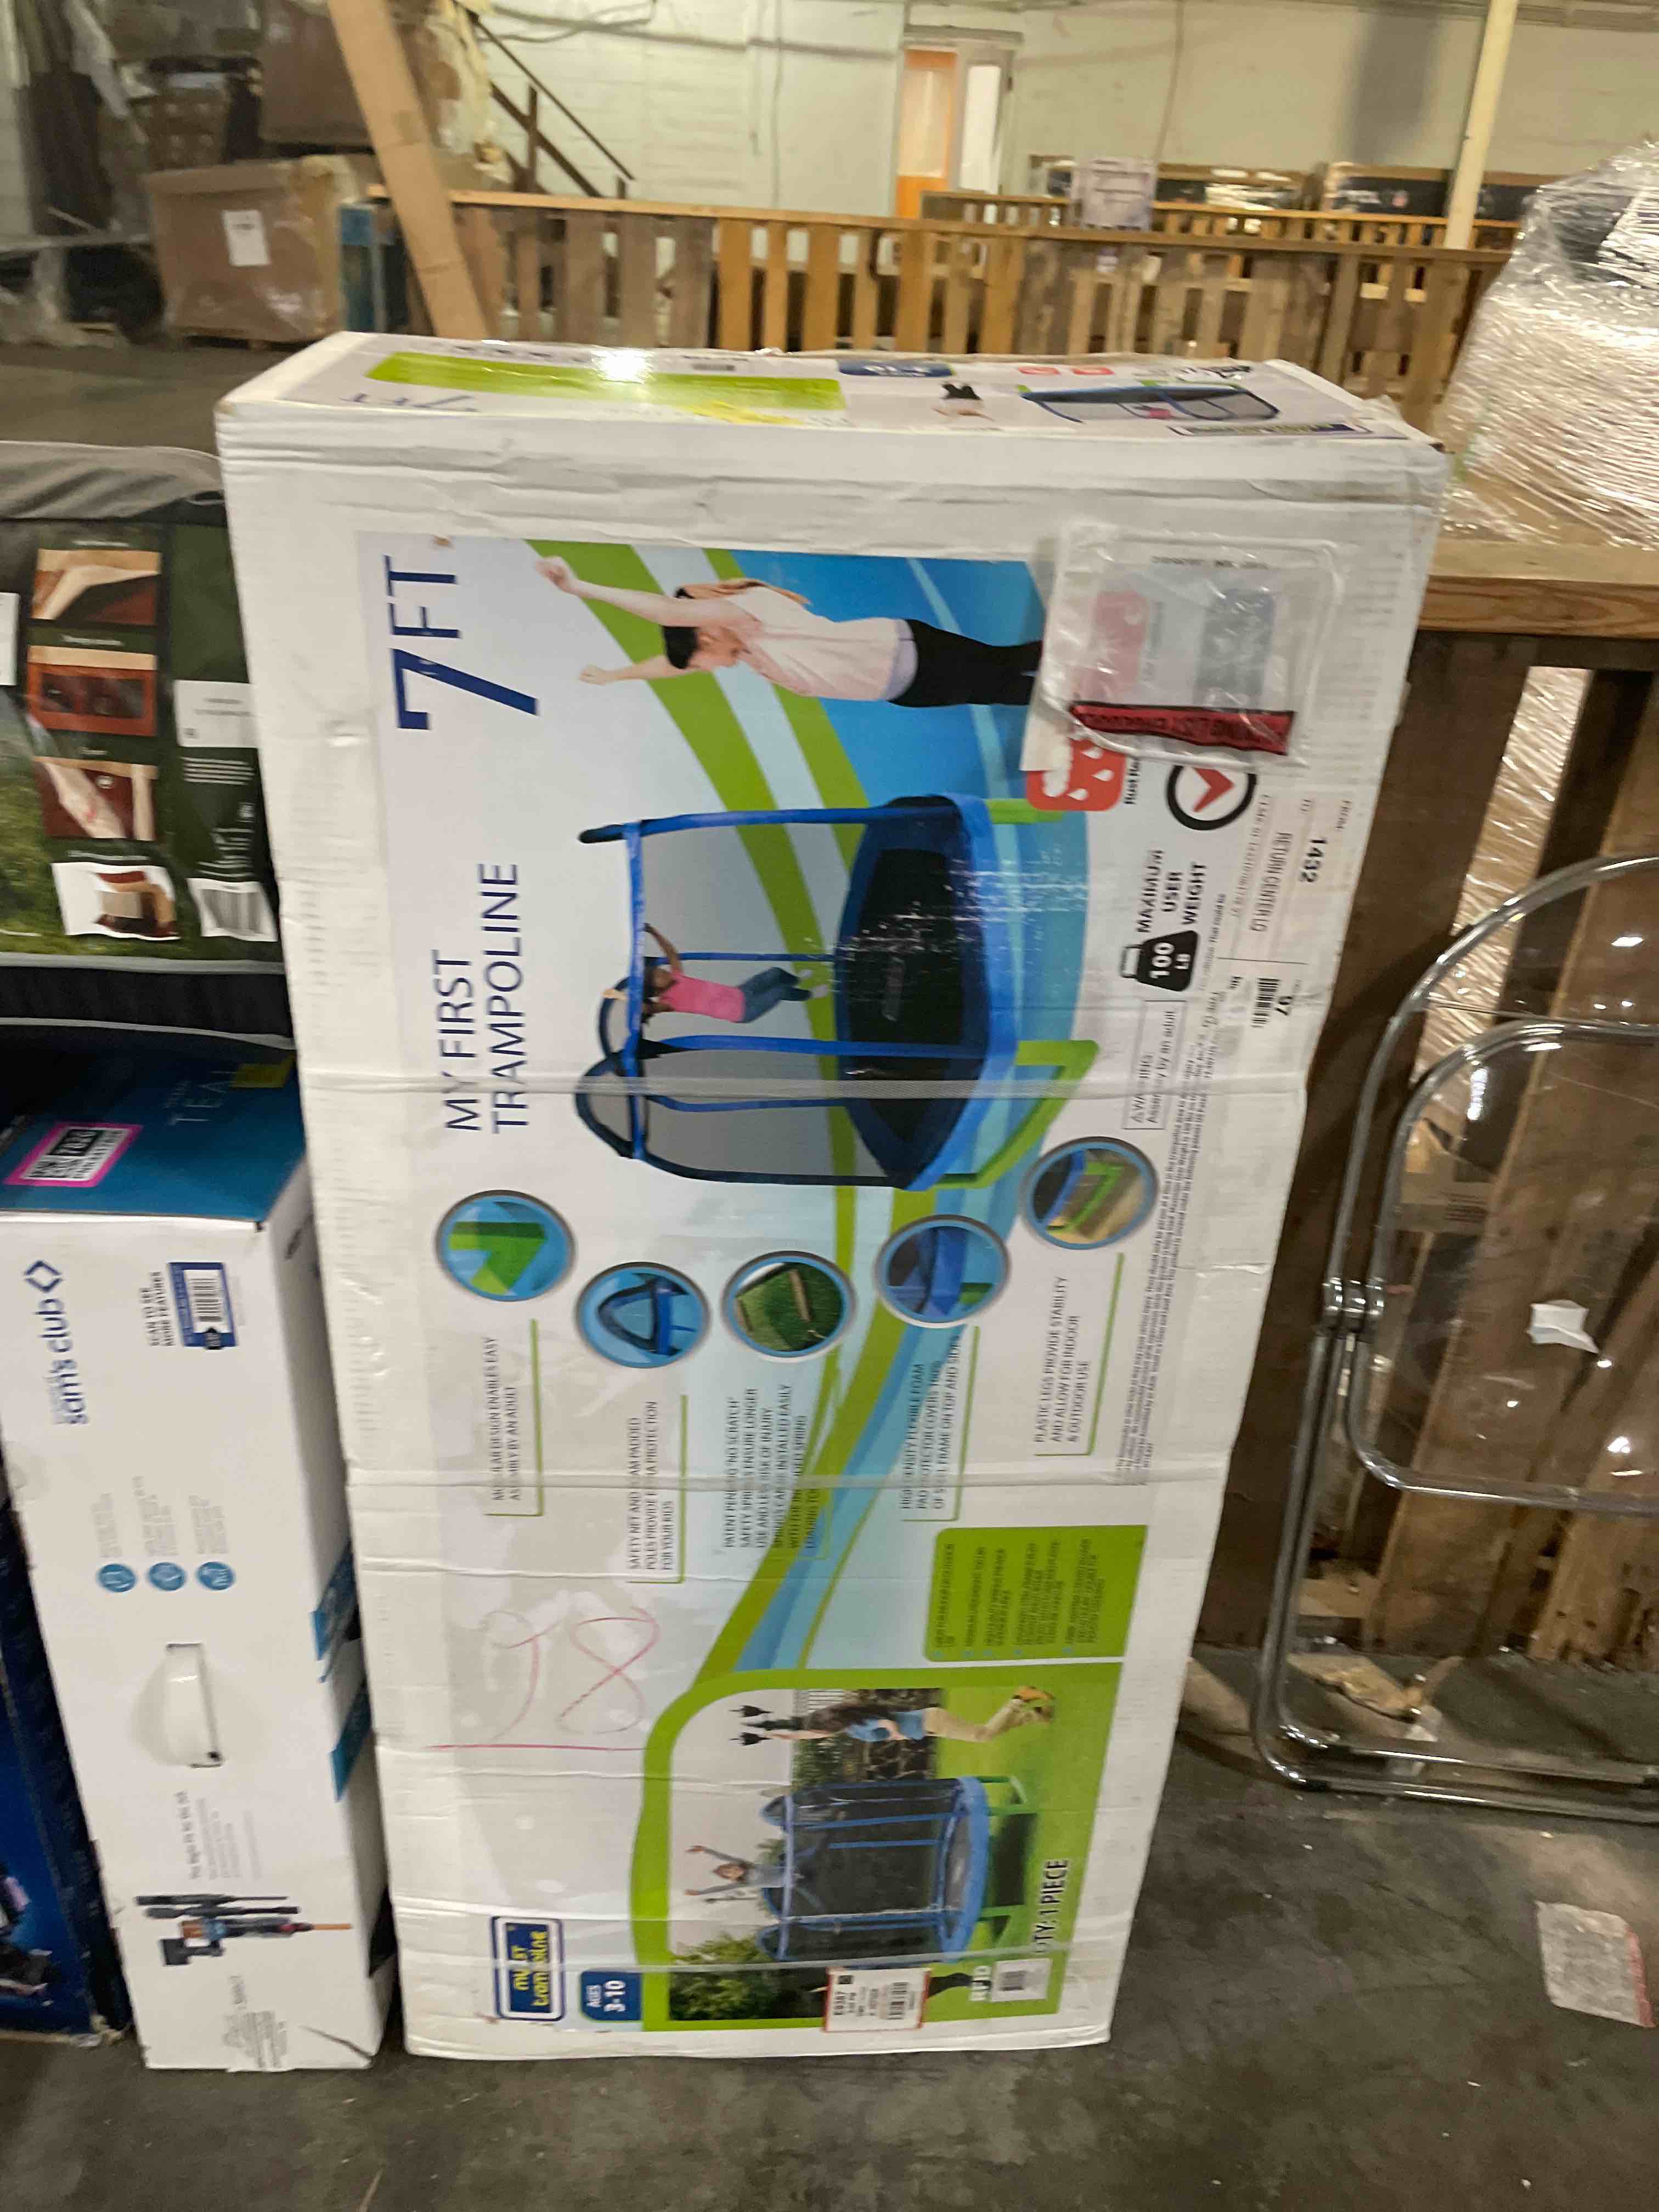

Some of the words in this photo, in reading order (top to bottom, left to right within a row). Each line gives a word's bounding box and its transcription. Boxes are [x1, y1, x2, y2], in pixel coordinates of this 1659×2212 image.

[381, 555, 461, 640] FT
[388, 648, 541, 732] 7
[1123, 780, 1139, 805] Rust
[1135, 850, 1165, 933] MAXIMUM
[1160, 871, 1183, 912] USER
[1180, 861, 1207, 926] WEIGHT
[1147, 941, 1176, 979] 100
[430, 948, 479, 1061] FIRST
[476, 863, 531, 1136] TRAMPOLINE
[441, 1072, 483, 1132] MY
[31, 1298, 72, 1353] club
[1037, 1859, 1068, 1904] PIECE
[530, 1931, 550, 2006] tramoline
[603, 1980, 627, 2012] 3-10
